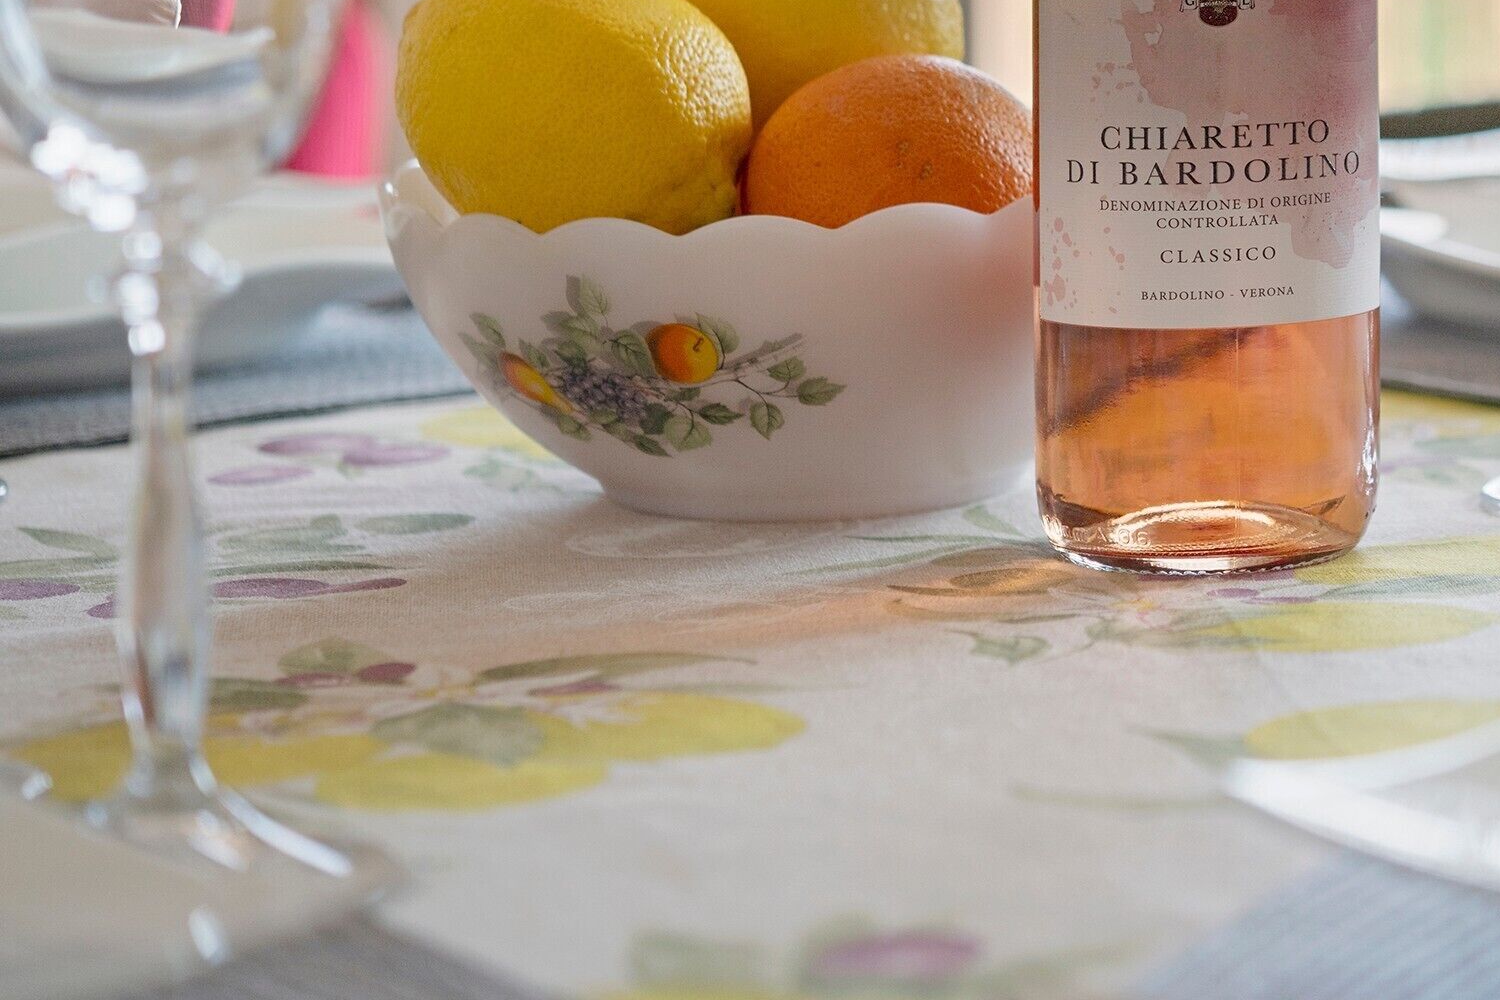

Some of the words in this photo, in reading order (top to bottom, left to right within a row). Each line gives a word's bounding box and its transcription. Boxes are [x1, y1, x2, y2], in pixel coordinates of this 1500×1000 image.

[1100, 119, 1330, 151] CHIARETTO
[1067, 159, 1100, 185] DI
[1119, 150, 1360, 186] BARDOLINO
[1099, 198, 1242, 212] DENOMINAZIONE
[1247, 197, 1265, 210] DI
[1270, 192, 1331, 208] ORIGINE
[1155, 214, 1279, 230] CONTROLLATA
[1159, 245, 1277, 264] CLASSICO
[1141, 289, 1225, 301] BARDOLINO
[1239, 286, 1295, 299] VERONA
